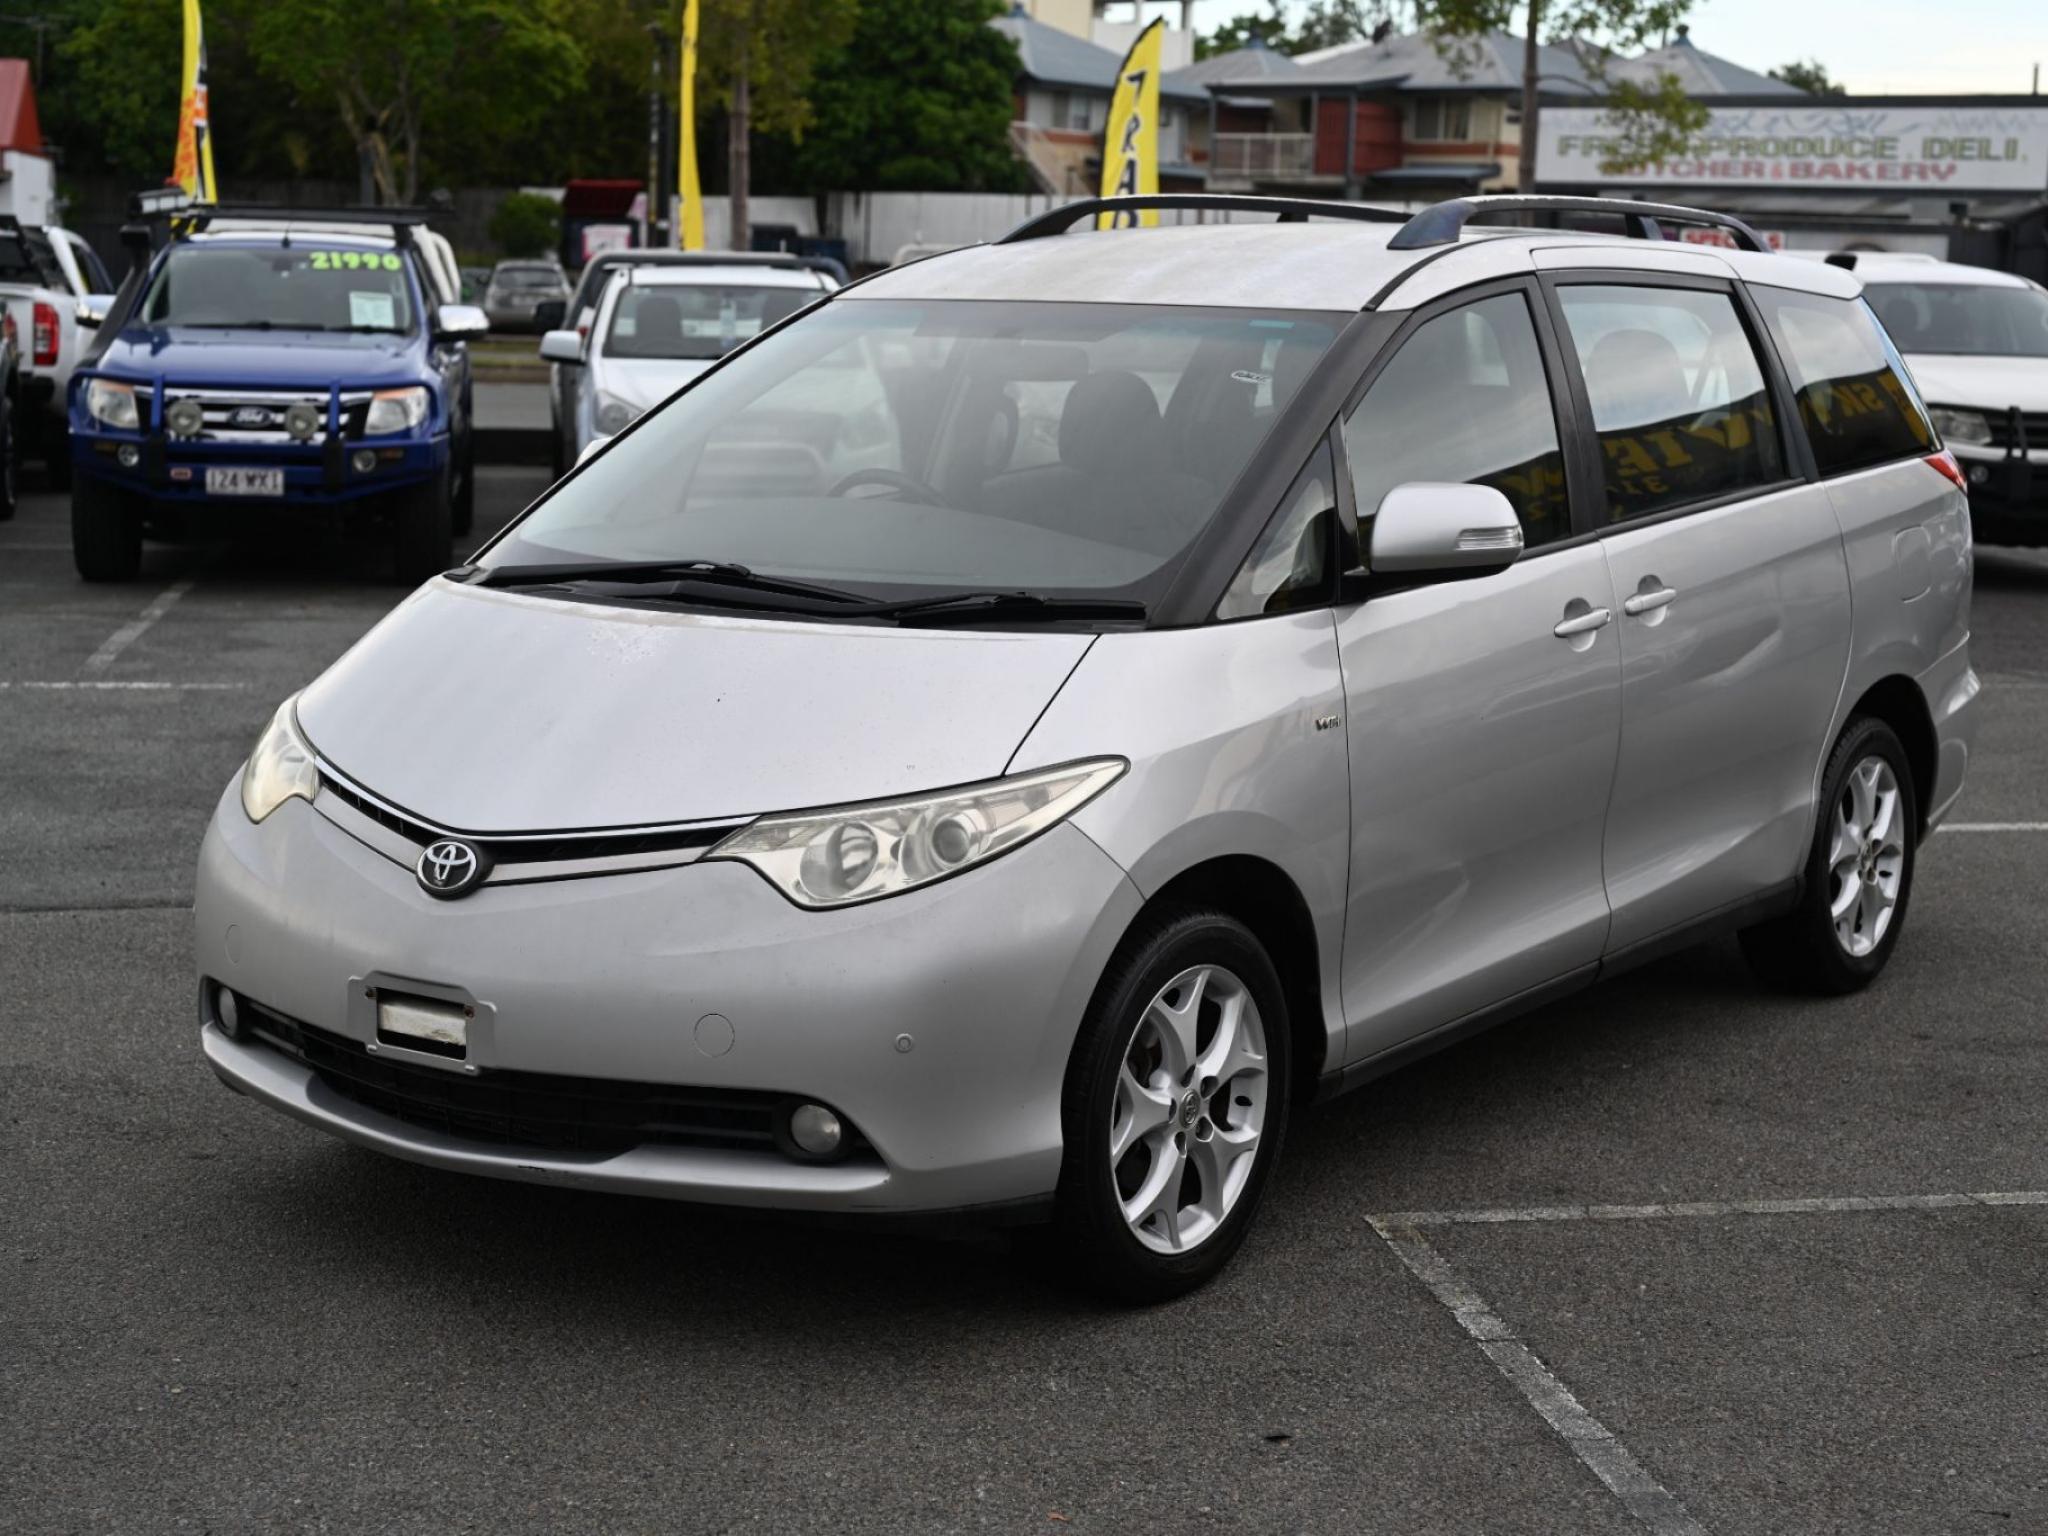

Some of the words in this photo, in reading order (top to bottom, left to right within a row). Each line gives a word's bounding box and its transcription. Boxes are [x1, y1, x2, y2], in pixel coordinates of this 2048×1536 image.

[1602, 160, 1764, 178] UTCHER
[1789, 161, 1957, 181] BAKERY
[310, 251, 401, 271] 21990
[208, 470, 239, 488] 124
